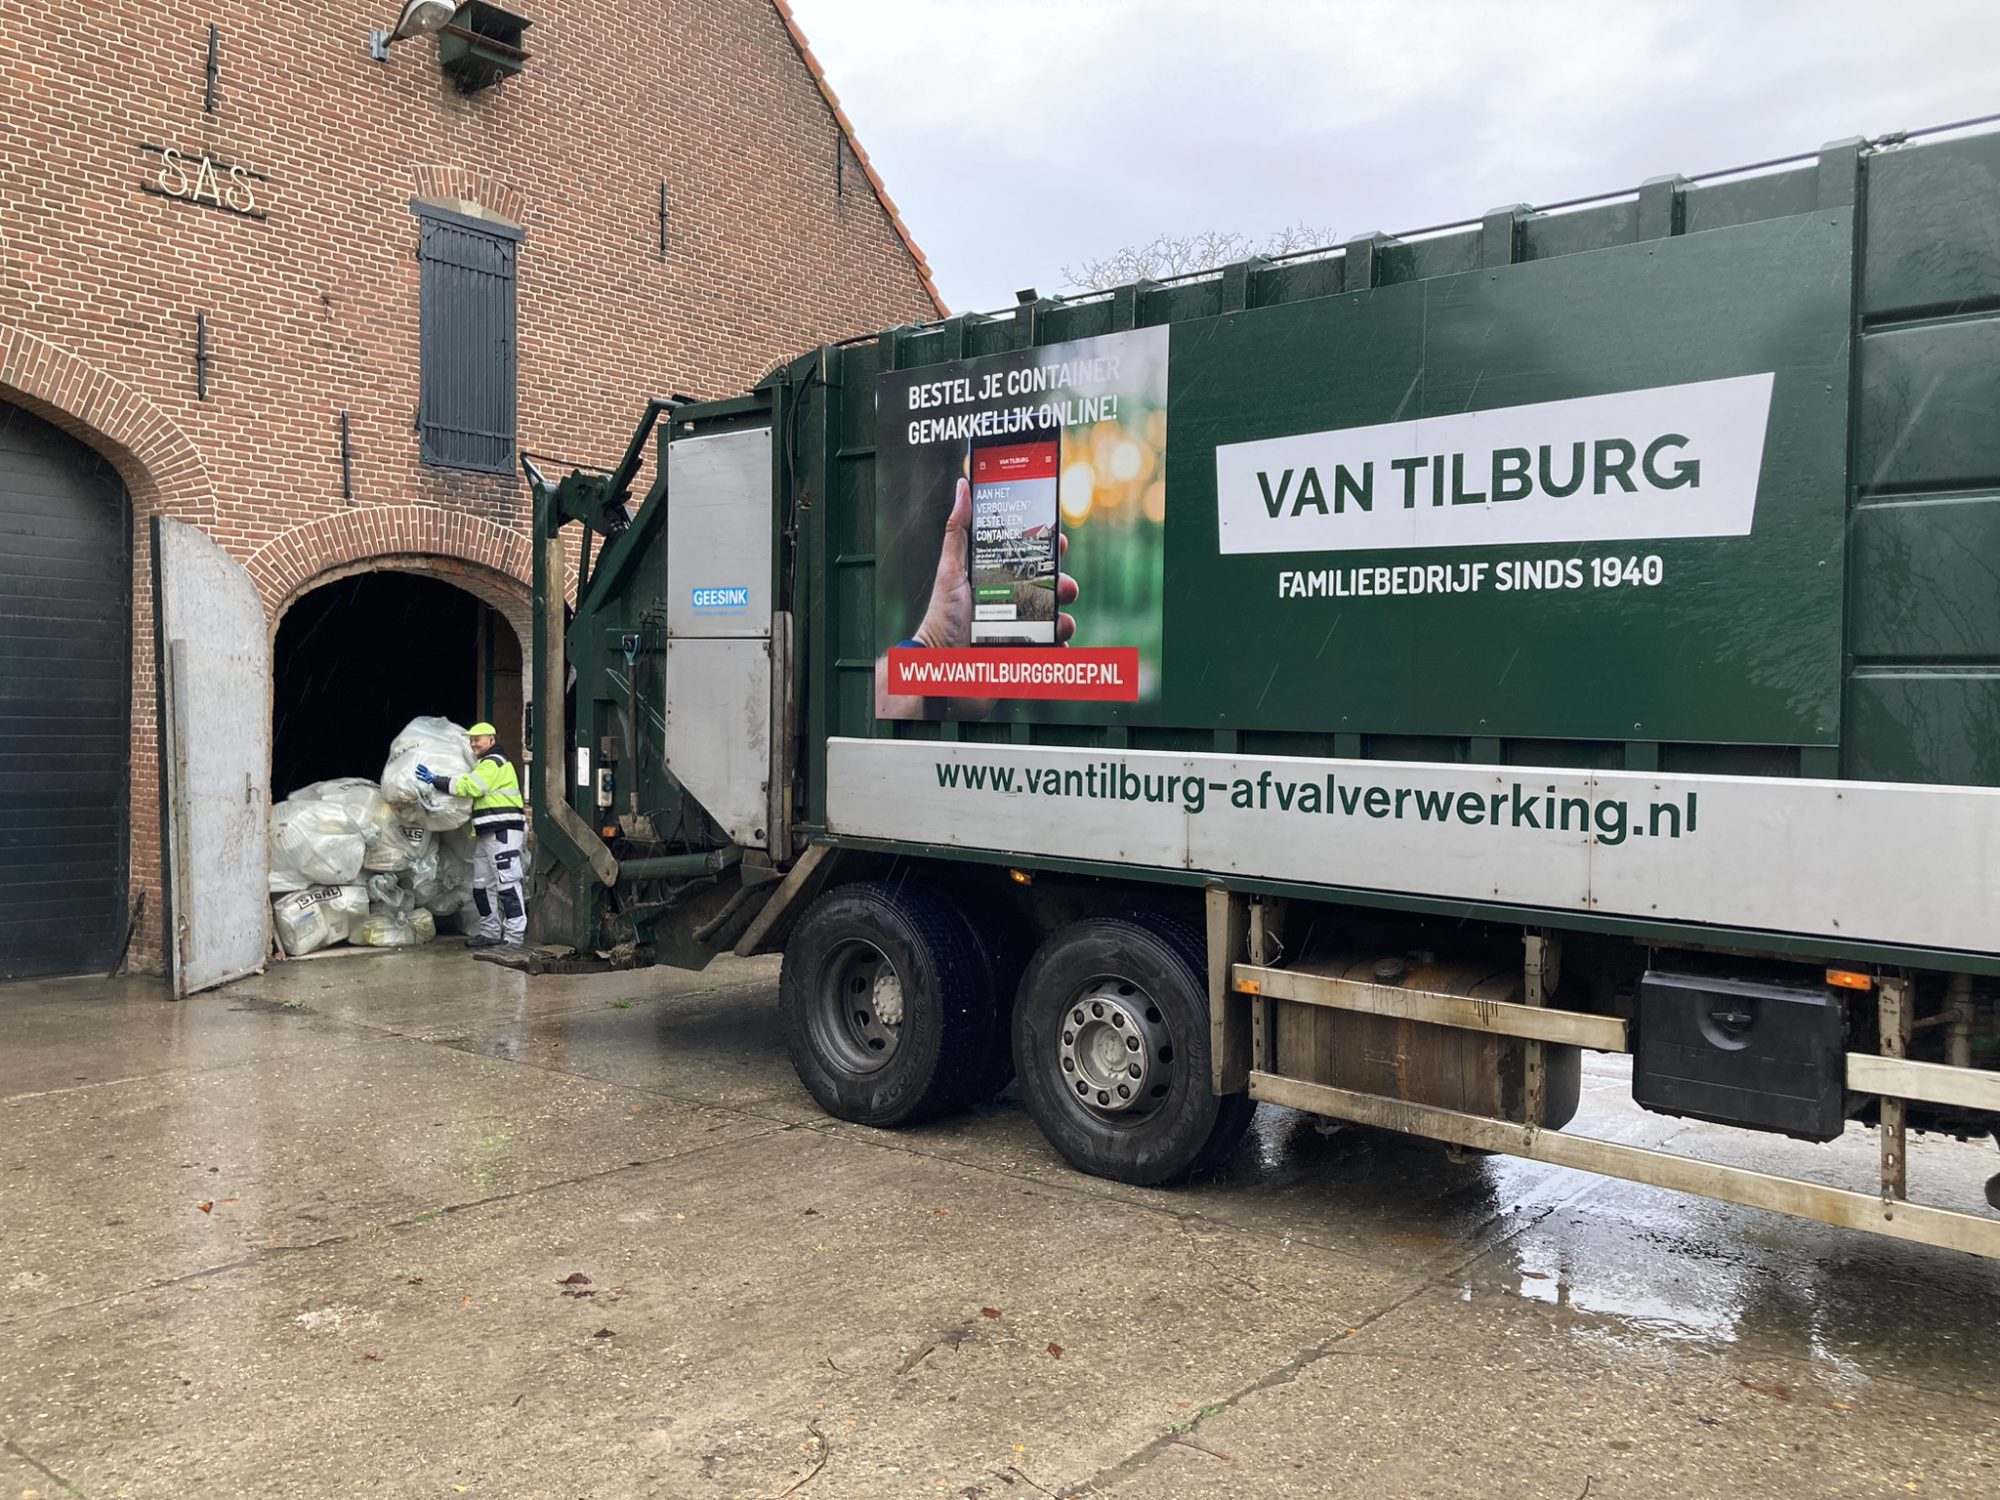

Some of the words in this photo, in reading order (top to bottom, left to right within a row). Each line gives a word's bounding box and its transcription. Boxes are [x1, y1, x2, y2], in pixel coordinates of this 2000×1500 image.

[159, 148, 254, 212] SAS
[909, 378, 976, 410] BESTEL
[978, 373, 1003, 399] JE
[1008, 356, 1120, 396] CONTAINER
[908, 406, 1035, 445] GEMAKKELIJK
[1039, 394, 1118, 429] ONLINE!
[976, 489, 993, 500] AAN
[994, 487, 1010, 499] HET
[1256, 461, 1374, 519] VAN
[1391, 433, 1701, 509] TILBURG
[976, 500, 1032, 514] VERBOUWEN?
[976, 515, 1005, 527] BESTEL
[1007, 514, 1023, 524] EEN
[693, 589, 747, 606] GEESINK
[1278, 562, 1489, 598] FAMILIEBEDRIJF
[1494, 558, 1583, 592] SINDS
[1590, 554, 1664, 588] 1940
[899, 662, 1123, 685] WWW.VANTILBURGGROEP.NL
[935, 762, 1698, 845] www.vantilburg-afvalverwerking.nl
